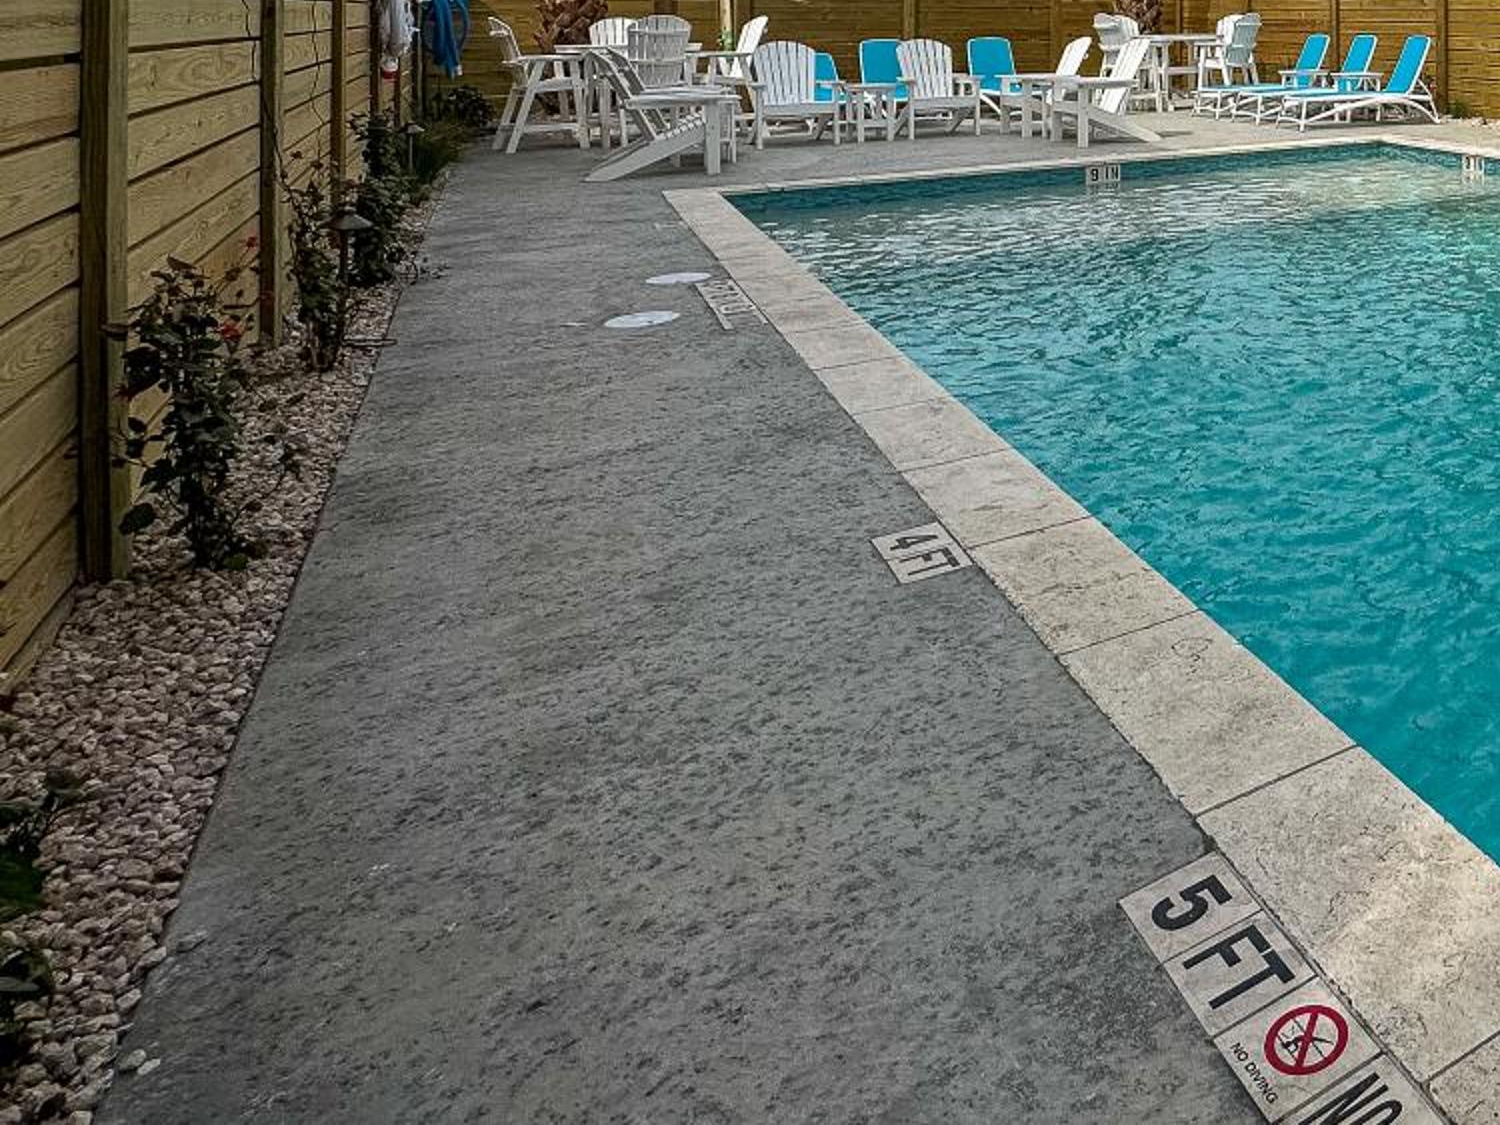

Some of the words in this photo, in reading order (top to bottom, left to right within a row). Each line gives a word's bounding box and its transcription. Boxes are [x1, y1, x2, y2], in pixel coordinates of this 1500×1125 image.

[1105, 166, 1119, 180] IN
[889, 534, 938, 551] 4
[899, 547, 960, 576] FT
[1150, 874, 1233, 931] 5
[1181, 924, 1297, 1010] FT
[1229, 1041, 1249, 1063] NO
[1244, 1062, 1279, 1105] DIVING
